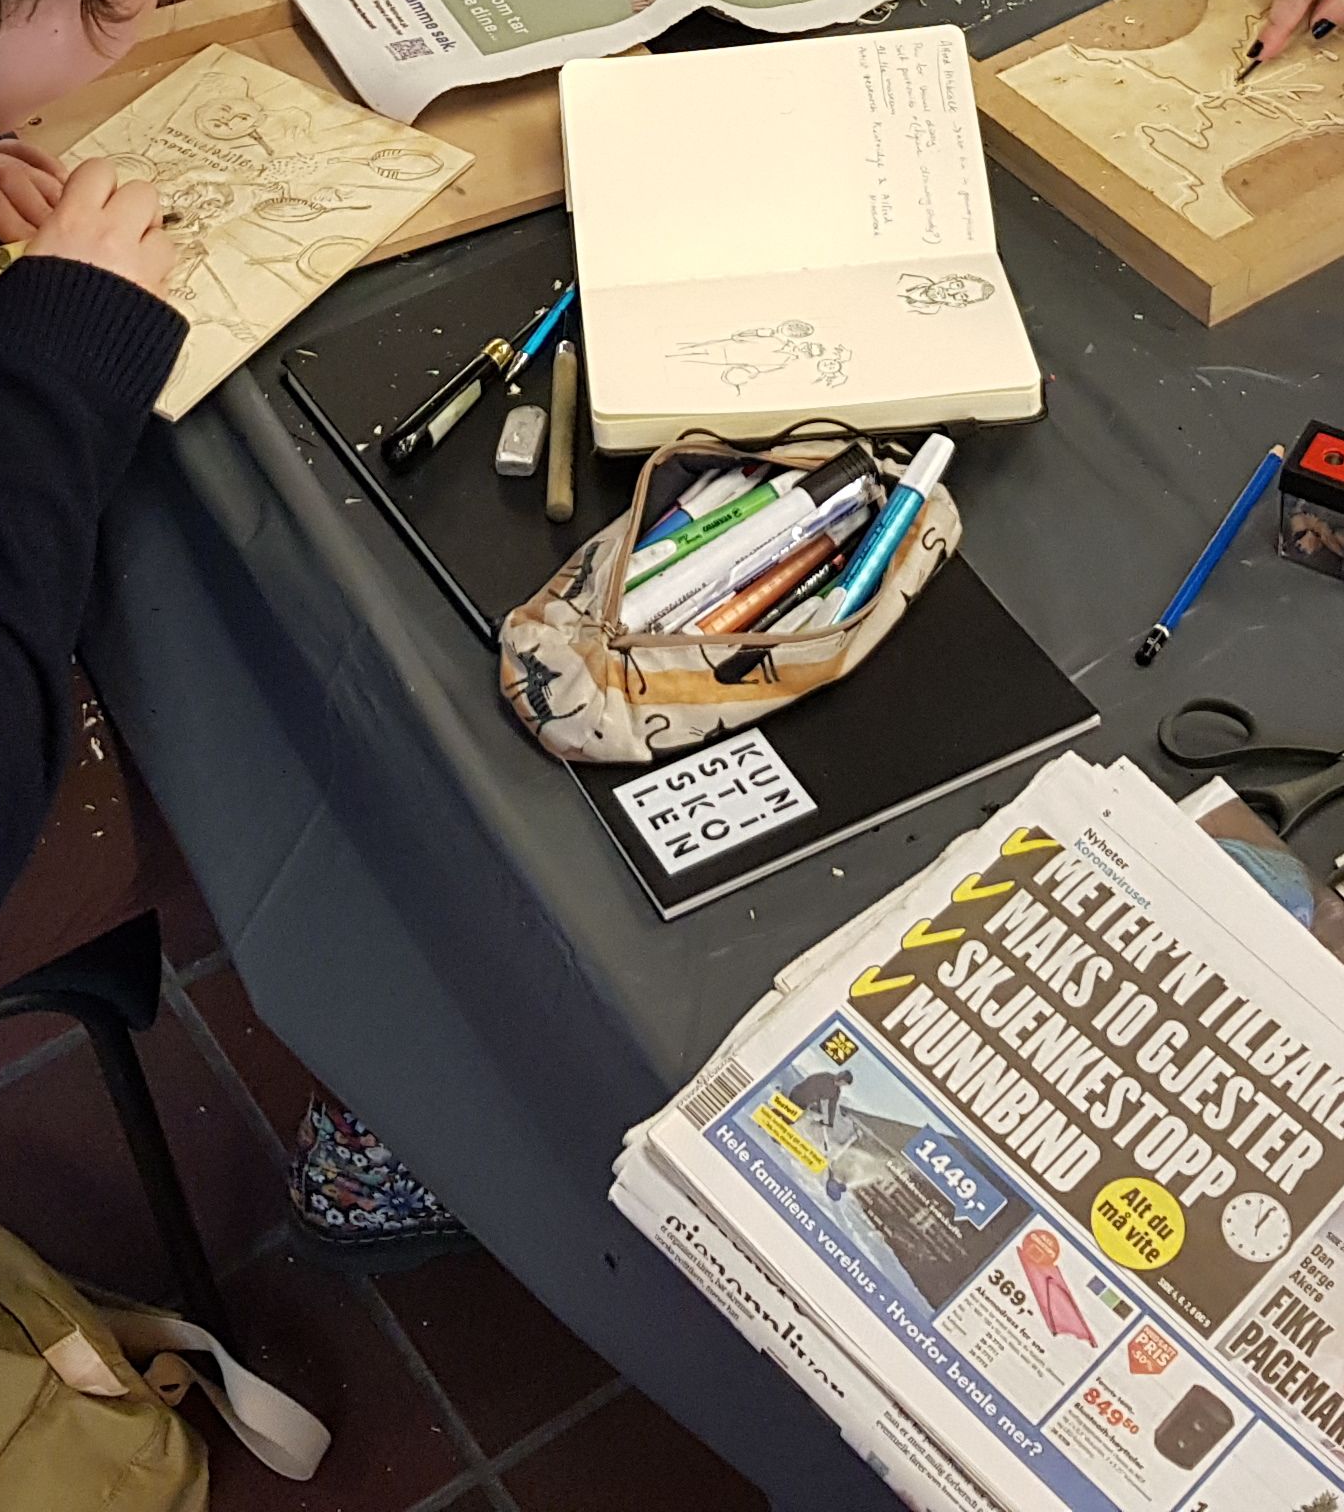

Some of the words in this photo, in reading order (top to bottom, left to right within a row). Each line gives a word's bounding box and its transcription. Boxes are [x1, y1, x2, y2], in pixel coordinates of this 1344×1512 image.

[431, 28, 456, 53] sak.
[507, 14, 529, 36] tar
[665, 769, 729, 841] SKO
[729, 741, 798, 813] KUN
[632, 785, 699, 858] LEN
[1081, 826, 1131, 873] Nyheter
[1071, 836, 1152, 912] Koronaviruset
[932, 933, 1242, 1217] SKJENKESTOPP
[981, 887, 1116, 1011] MAKS
[1088, 979, 1164, 1051] 10
[1130, 1015, 1329, 1194] GJESTER
[878, 981, 1105, 1197] MUNNBIND
[910, 1136, 993, 1218] 1449,-
[1093, 1195, 1132, 1233] må
[1122, 1220, 1167, 1264] vite
[1117, 1184, 1154, 1221] Alt
[1144, 1209, 1178, 1242] du
[713, 1122, 754, 1164] Hele
[747, 1157, 821, 1233] familiens
[814, 1226, 881, 1295] varehus
[883, 1299, 950, 1368] Hvorfor
[944, 1360, 1001, 1418] betale
[996, 1413, 1044, 1459] mer?
[1288, 1267, 1326, 1304] Akerø
[1298, 1255, 1337, 1293] Børge
[1310, 1243, 1336, 1269] Dan
[982, 1266, 1040, 1322] 369,-
[1258, 1284, 1334, 1357] FIKK
[1018, 1326, 1033, 1341] for
[1030, 1338, 1047, 1355] snø
[1133, 1331, 1172, 1368] PRIS
